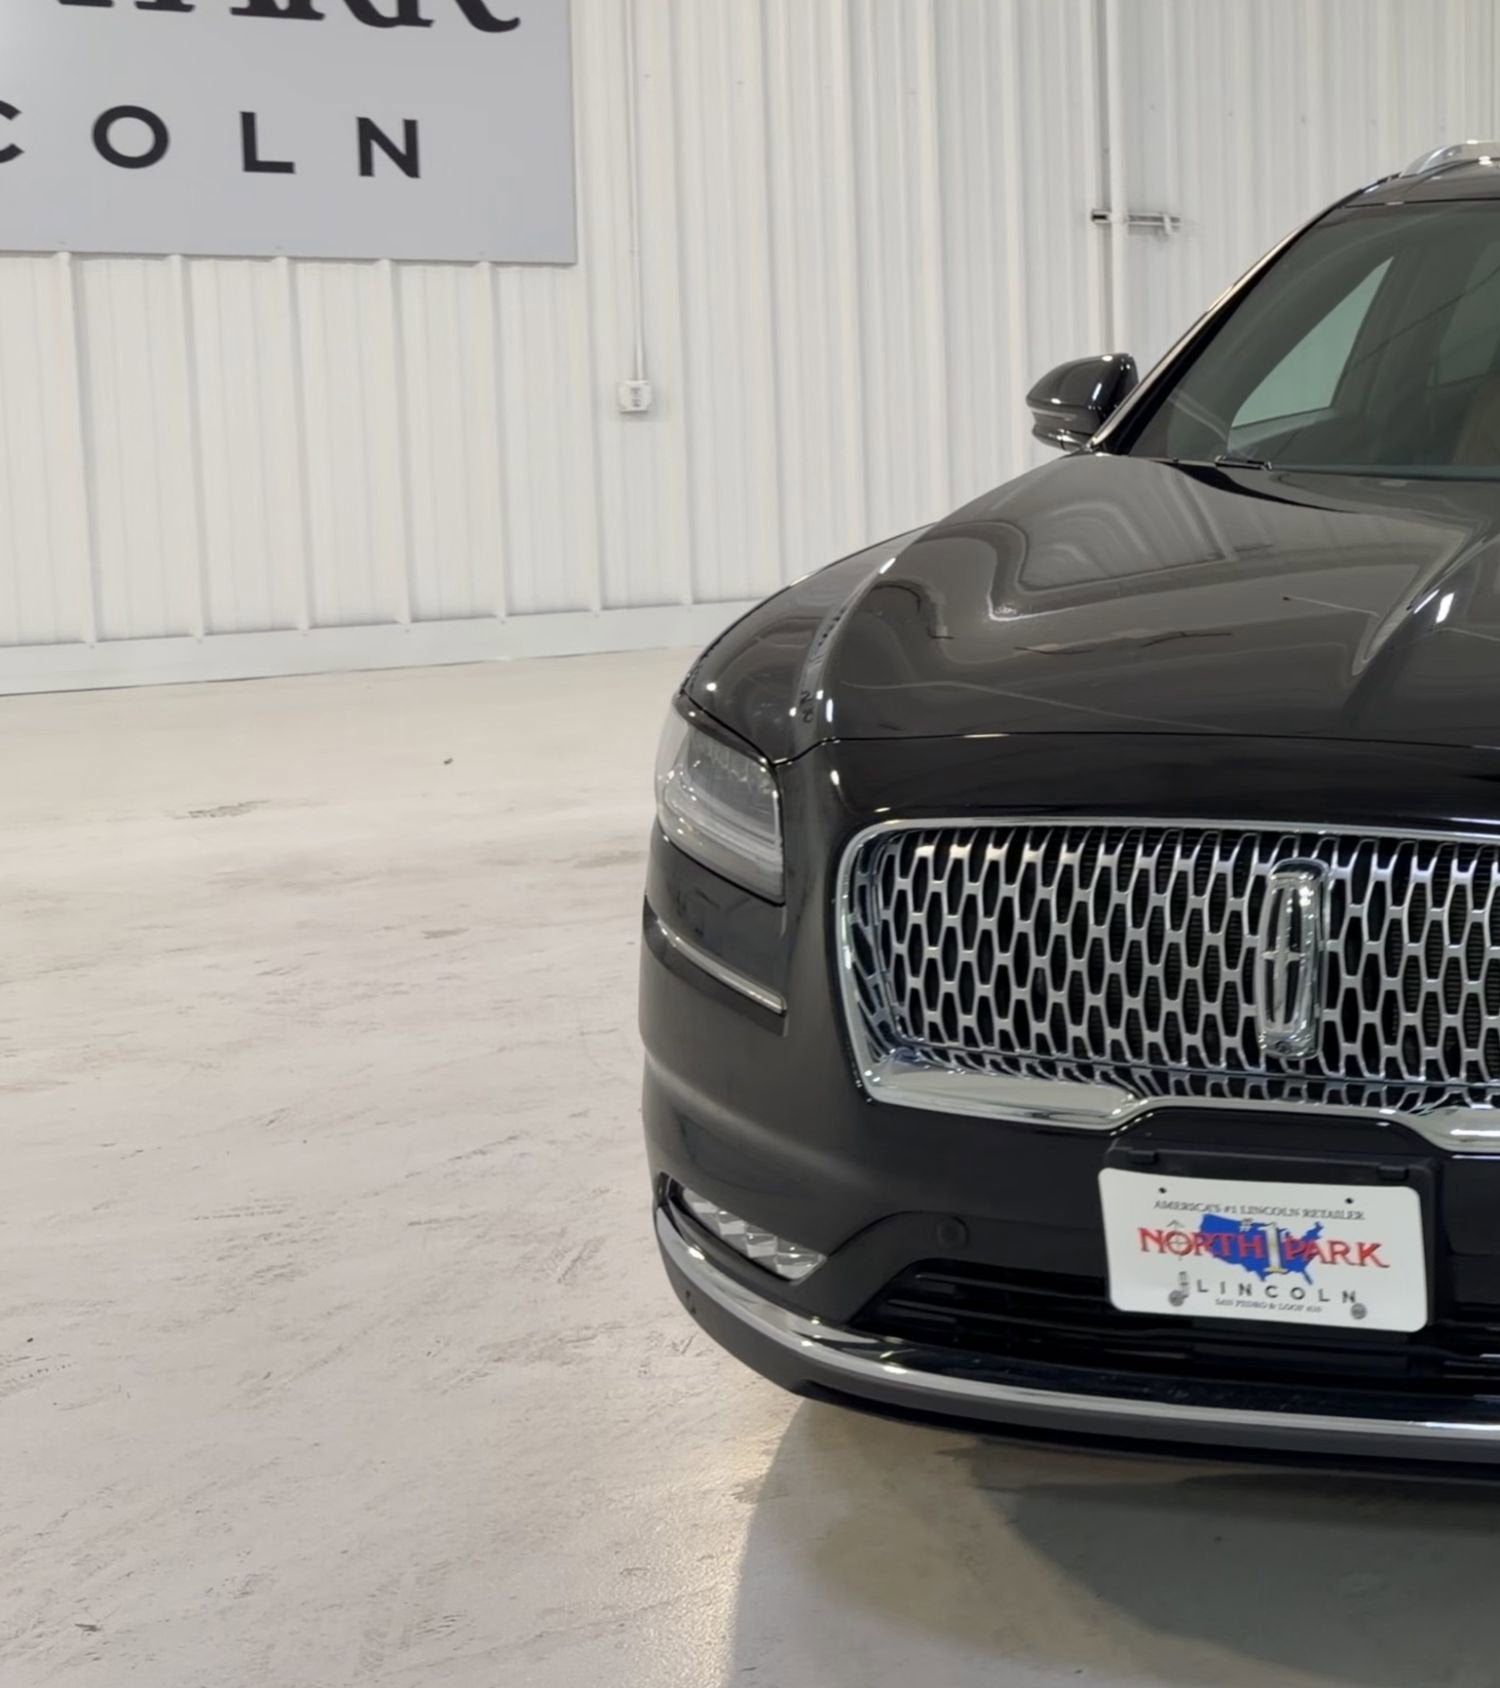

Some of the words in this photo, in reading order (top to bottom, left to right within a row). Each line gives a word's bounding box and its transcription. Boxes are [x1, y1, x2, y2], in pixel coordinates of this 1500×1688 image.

[1153, 1200, 1223, 1214] AMERICA'S
[1239, 1204, 1300, 1217] LINCOLN
[1301, 1208, 1366, 1221] RETAILER
[1137, 1227, 1265, 1260] NORTH
[1284, 1234, 1391, 1268] PARK
[1196, 1279, 1357, 1303] LINCOLN
